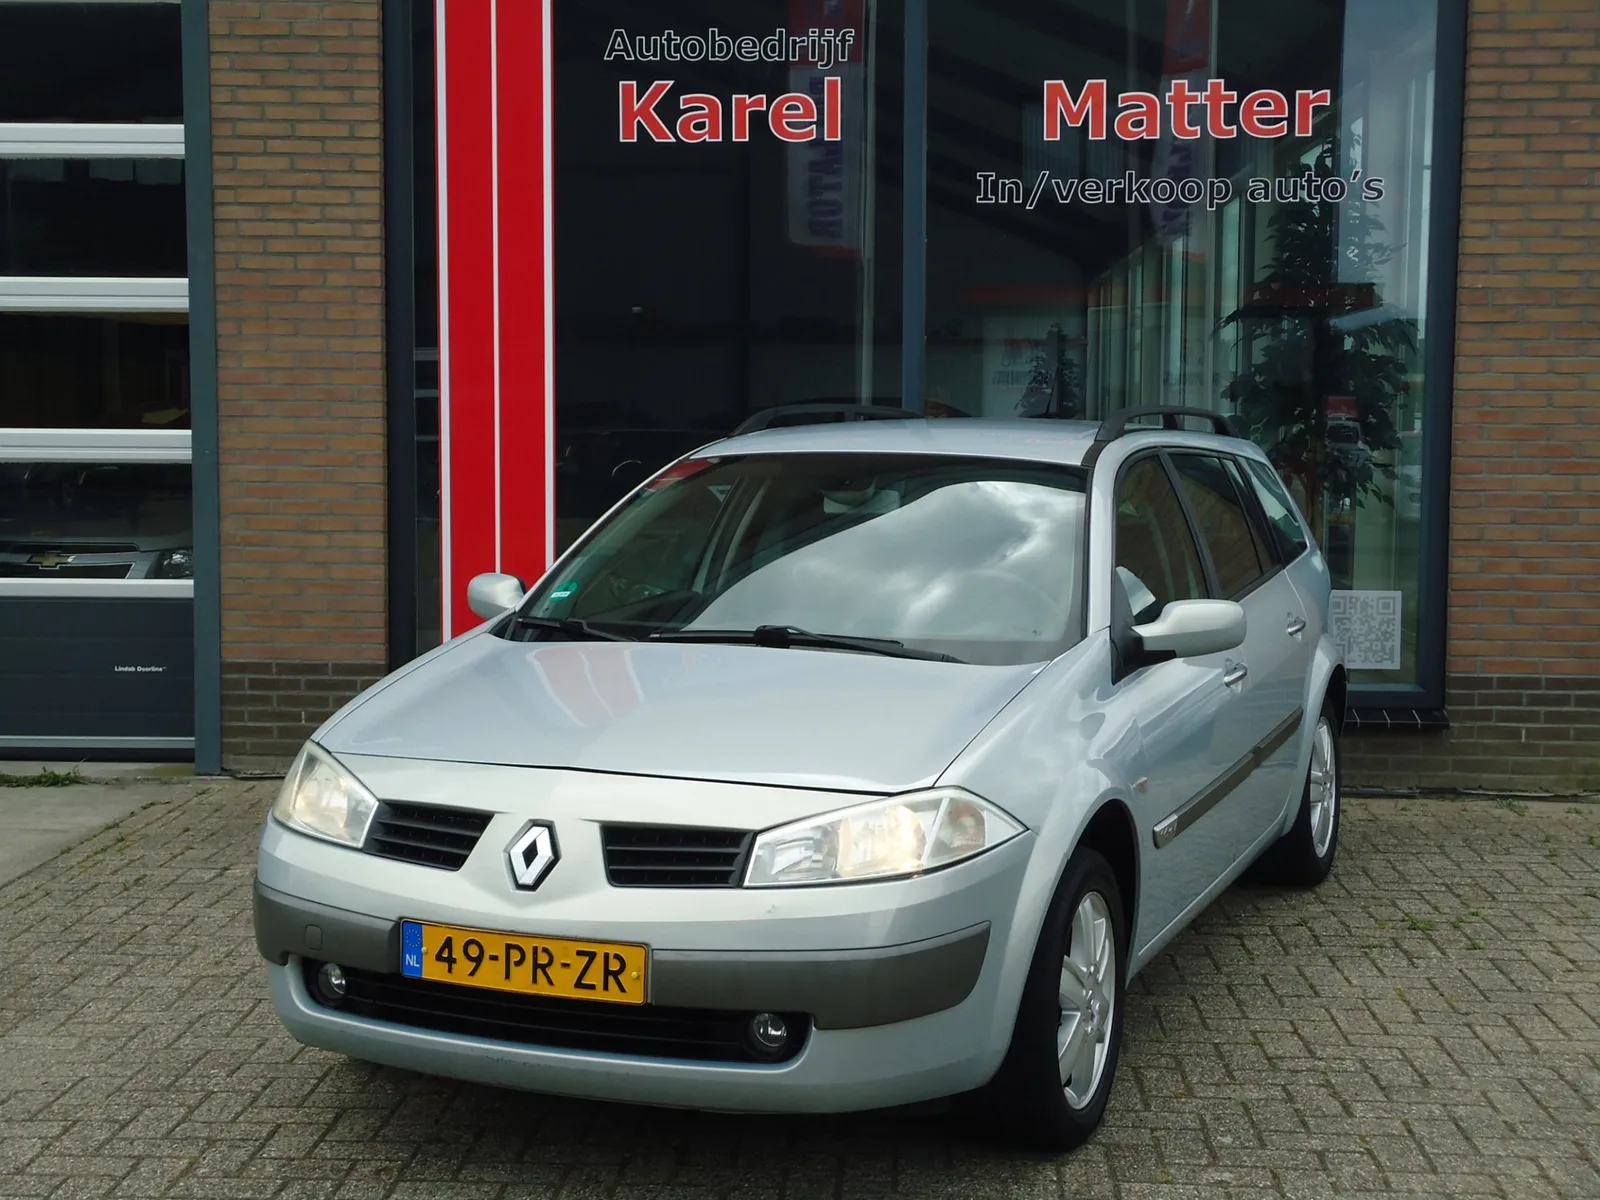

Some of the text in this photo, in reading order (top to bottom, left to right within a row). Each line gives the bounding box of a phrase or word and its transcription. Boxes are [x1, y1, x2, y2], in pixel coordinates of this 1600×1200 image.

[604, 27, 855, 69] Autobedrijf
[618, 76, 1332, 143] Karel Matter
[975, 169, 1386, 210] In/verkoop auto's
[405, 953, 420, 968] NL
[434, 936, 627, 993] 49-PR-ZR
